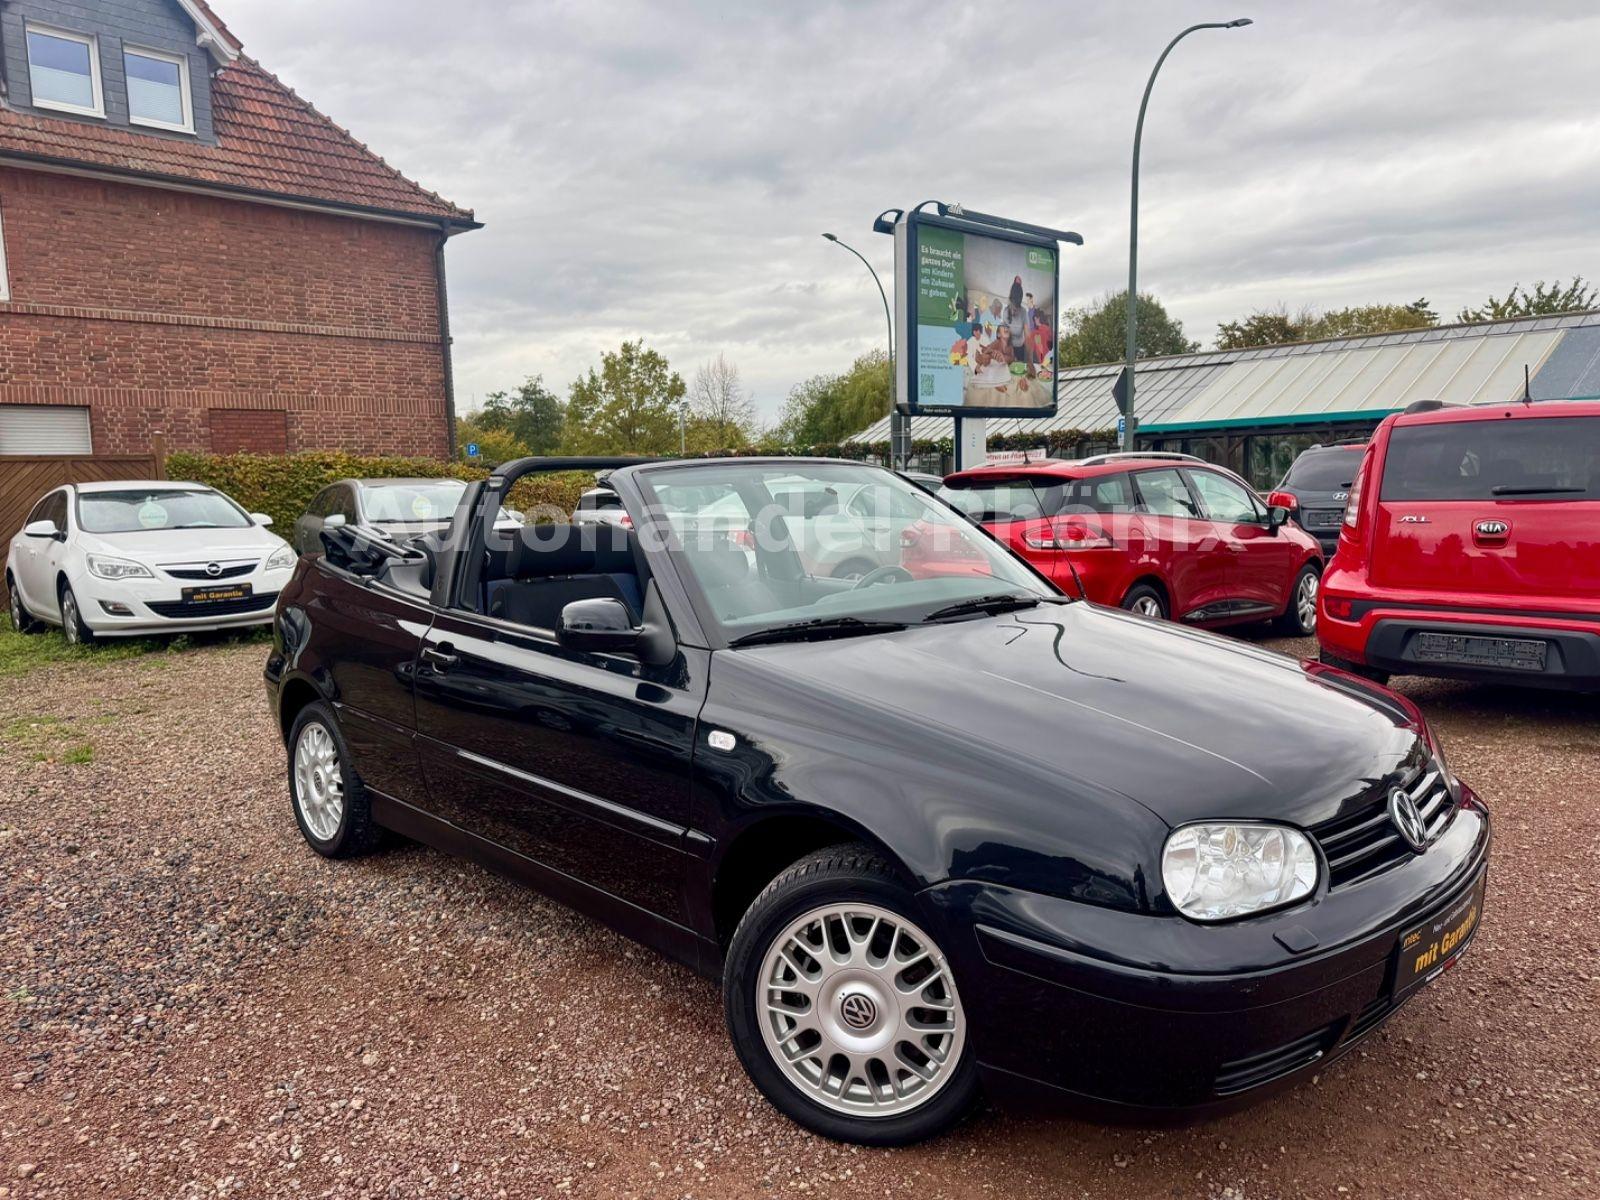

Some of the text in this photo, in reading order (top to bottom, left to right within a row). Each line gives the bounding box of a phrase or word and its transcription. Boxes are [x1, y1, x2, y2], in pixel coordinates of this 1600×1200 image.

[1480, 523, 1502, 533] KIA
[193, 592, 207, 601] mit
[209, 590, 243, 599] Garantie
[1414, 942, 1439, 973] mit
[1441, 904, 1477, 955] Garantie
